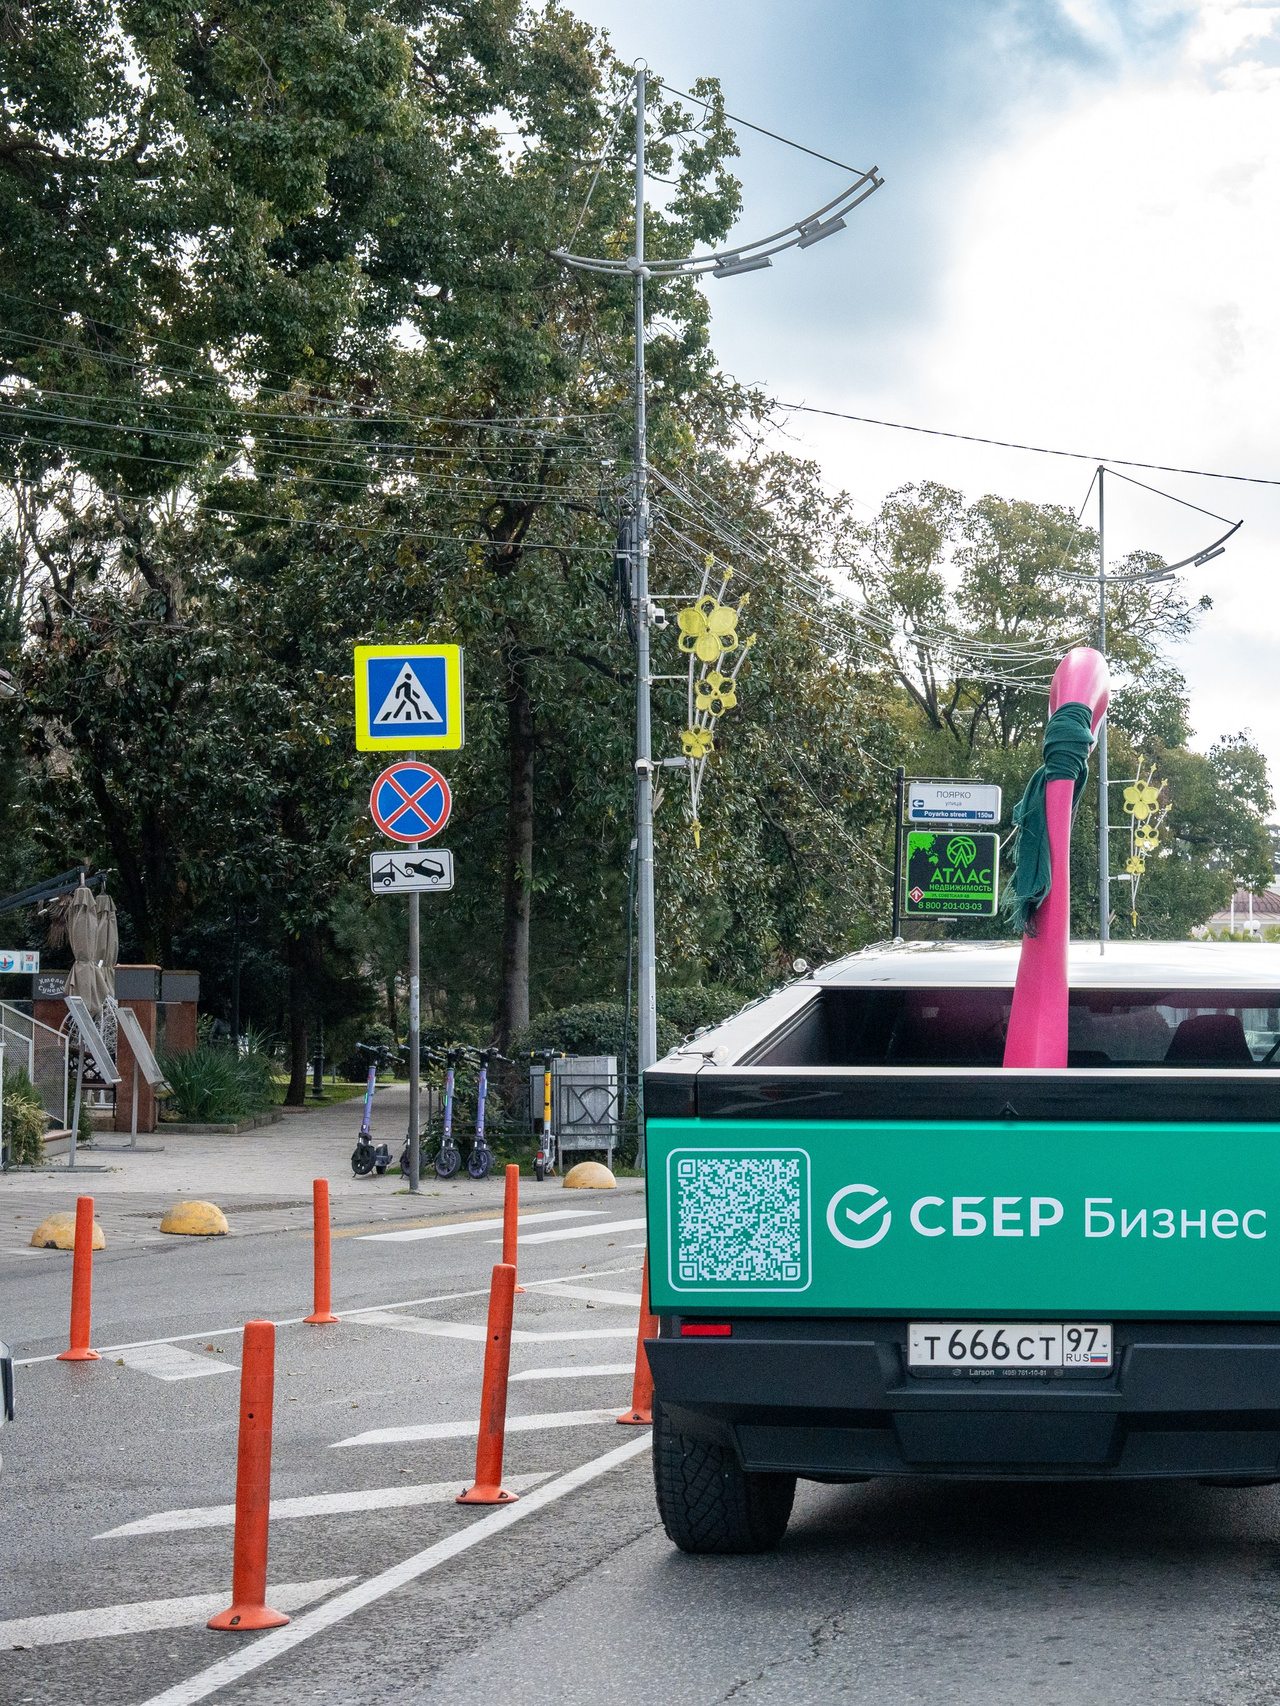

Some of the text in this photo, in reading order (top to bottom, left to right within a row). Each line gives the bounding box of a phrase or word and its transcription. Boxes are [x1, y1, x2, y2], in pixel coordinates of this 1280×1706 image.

[936, 790, 971, 799] ПОЯРКО
[924, 810, 949, 818] Poyarko
[930, 867, 991, 885] АТЛАС
[943, 902, 982, 910] 201-03-03
[39, 977, 64, 985] Хмели
[909, 1195, 1268, 1240] СБЕР Бизнес
[924, 1328, 1099, 1361] Т666СТ 97
[1065, 1353, 1089, 1362] RUS
[969, 1368, 995, 1376] Larson
